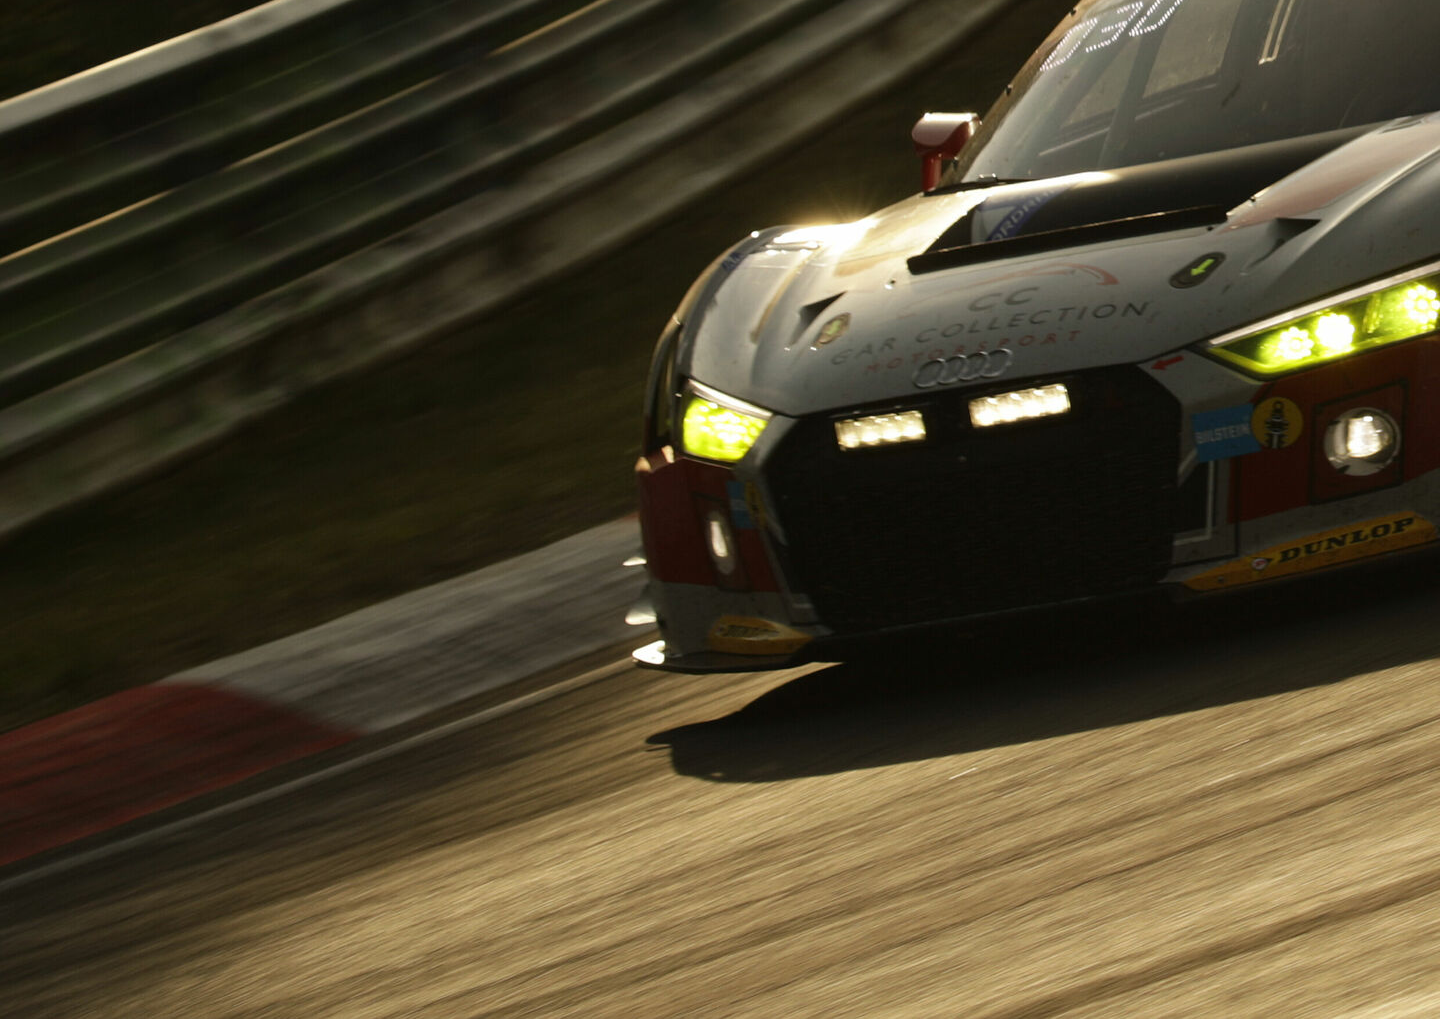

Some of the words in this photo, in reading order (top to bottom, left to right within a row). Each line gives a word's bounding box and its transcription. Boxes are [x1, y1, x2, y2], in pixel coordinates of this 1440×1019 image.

[969, 286, 1039, 312] CC
[831, 337, 897, 365] CAR
[915, 302, 1150, 344] COLLECTION
[1279, 517, 1415, 562] DUNLOP
